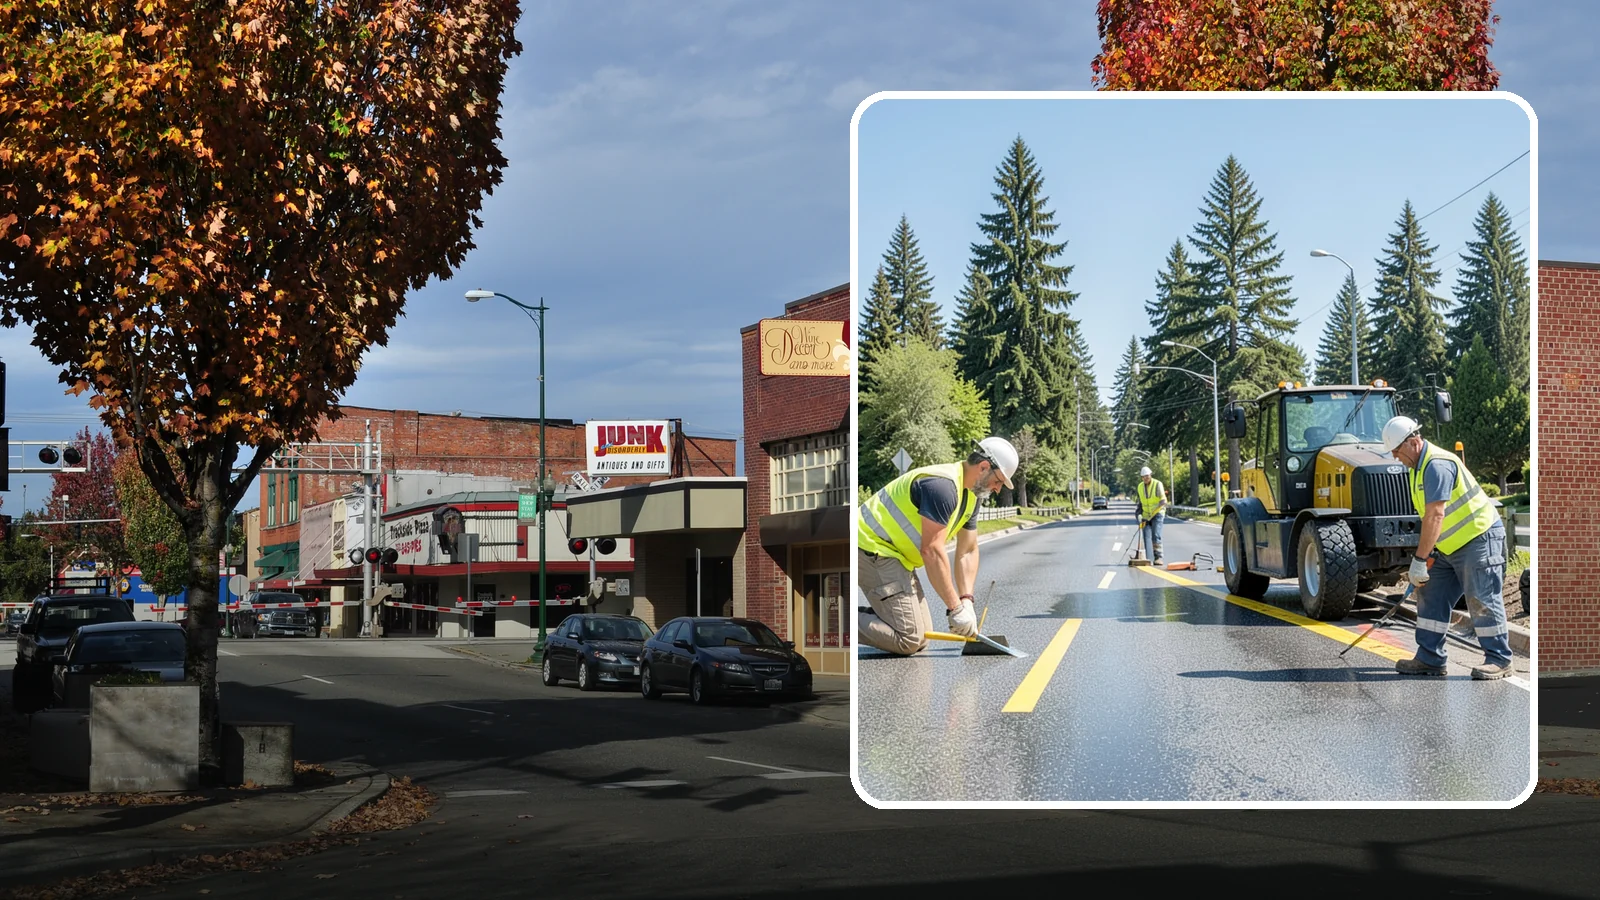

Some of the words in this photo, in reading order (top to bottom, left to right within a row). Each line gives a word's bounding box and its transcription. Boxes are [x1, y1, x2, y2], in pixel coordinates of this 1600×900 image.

[595, 425, 665, 457] JUNK
[607, 446, 646, 454] DISORDERLY
[596, 461, 628, 470] ANTIQUES
[631, 461, 643, 470] AND
[647, 460, 665, 469] GIFTS
[390, 522, 413, 540] Trackside
[414, 519, 429, 535] Pizza
